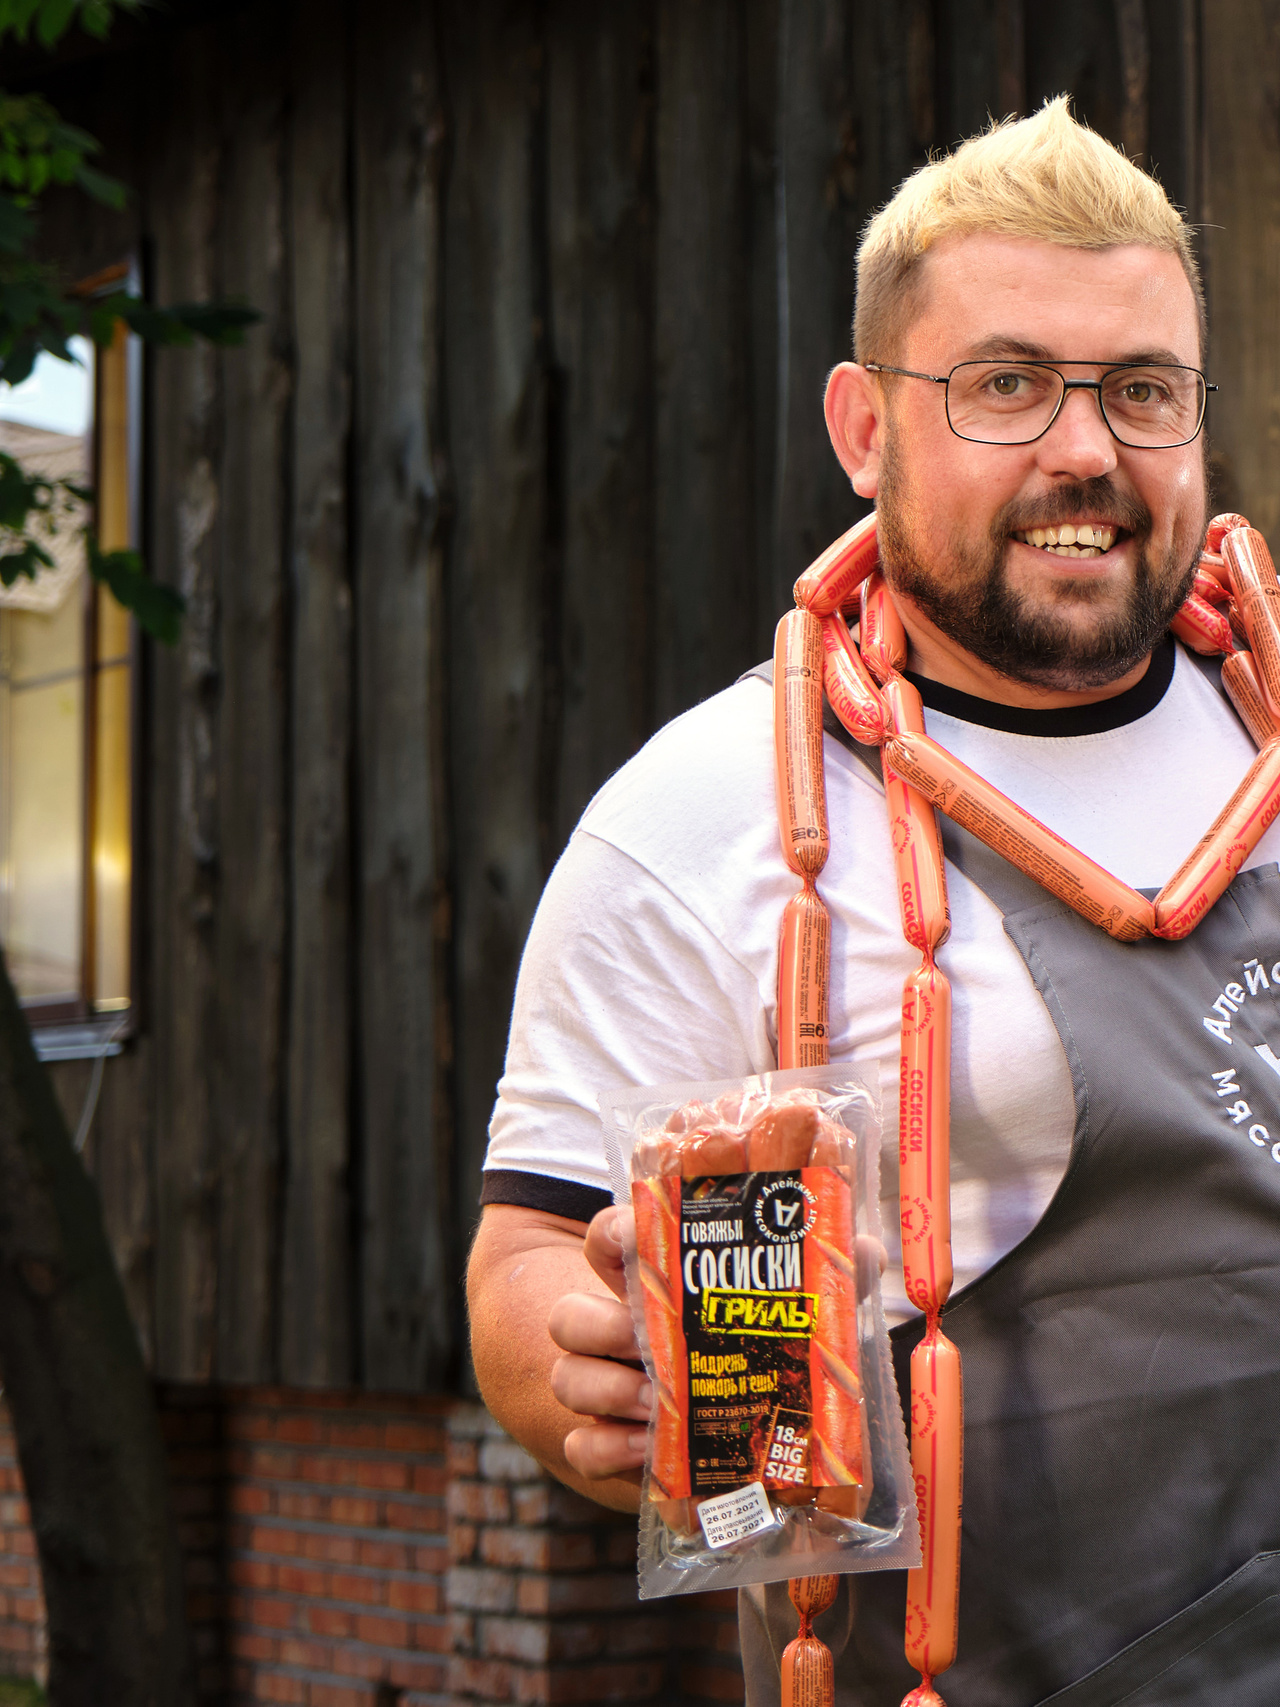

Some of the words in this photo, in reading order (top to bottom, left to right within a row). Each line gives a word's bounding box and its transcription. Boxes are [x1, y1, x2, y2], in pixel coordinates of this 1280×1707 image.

[762, 1176, 818, 1205] Алейский
[682, 1219, 743, 1244] ГОВЯЖЬИ
[684, 1242, 801, 1294] СОСИСКИ
[708, 1296, 810, 1328] ГРИЛЬ
[690, 1351, 748, 1378] Надрежь
[692, 1378, 738, 1399] пожарь
[738, 1376, 747, 1395] и
[749, 1370, 778, 1392] ешь!
[697, 1409, 717, 1418] ГОСТ
[725, 1405, 769, 1417] 23670-2019
[770, 1443, 803, 1464] BIG
[765, 1462, 807, 1484] SIZE
[702, 1508, 716, 1516] Дата
[706, 1499, 759, 1524] 26.07.2021
[707, 1526, 722, 1536] Дата
[712, 1517, 765, 1543] 26.07.2021
